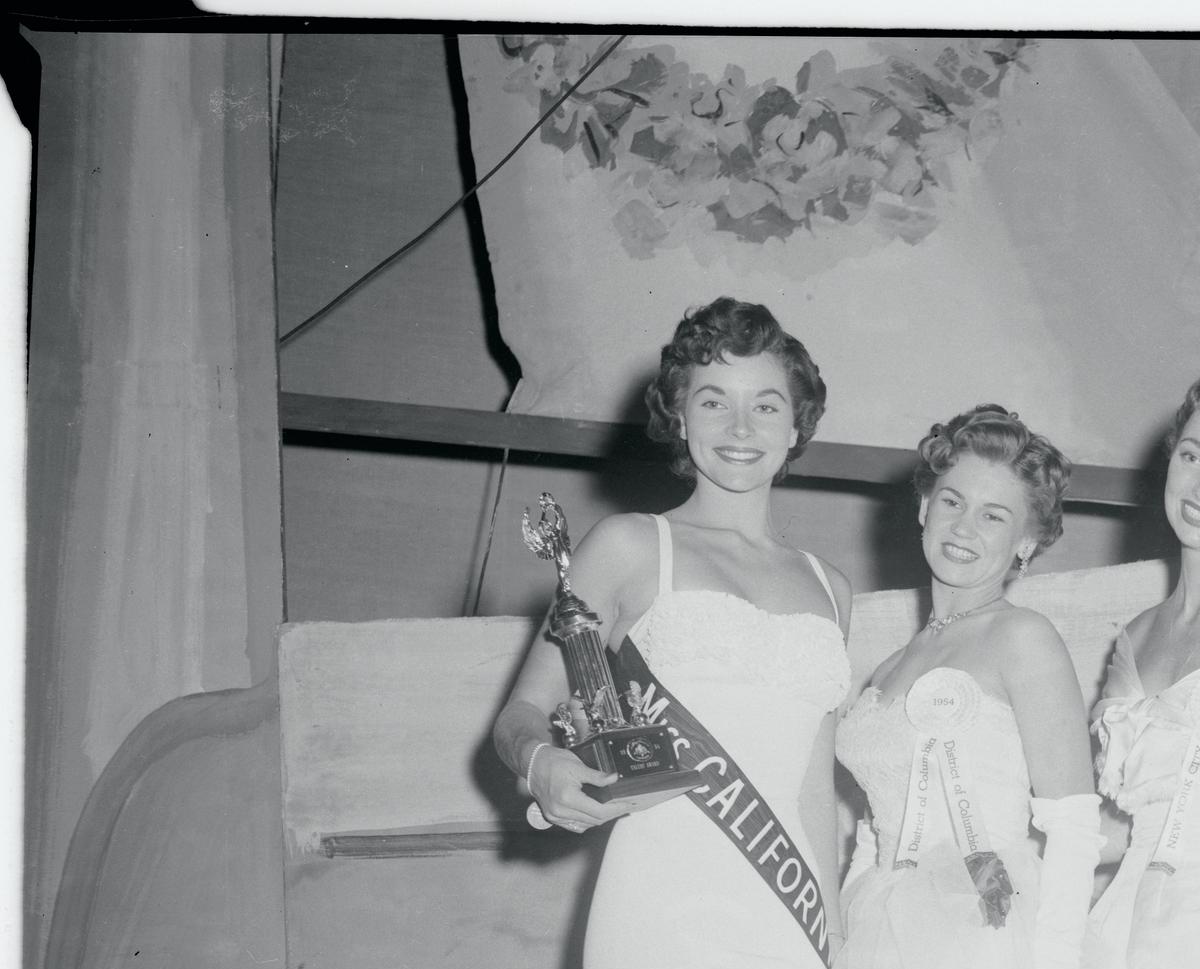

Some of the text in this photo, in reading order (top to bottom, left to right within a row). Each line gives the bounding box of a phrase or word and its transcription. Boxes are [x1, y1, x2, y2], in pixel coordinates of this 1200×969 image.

[932, 697, 955, 707] 1954
[907, 737, 937, 852] District of Columbia
[943, 740, 980, 852] District of Columbia
[1166, 819, 1184, 850] NEW
[1176, 778, 1194, 816] YORK
[691, 756, 830, 961] CALIFORN
